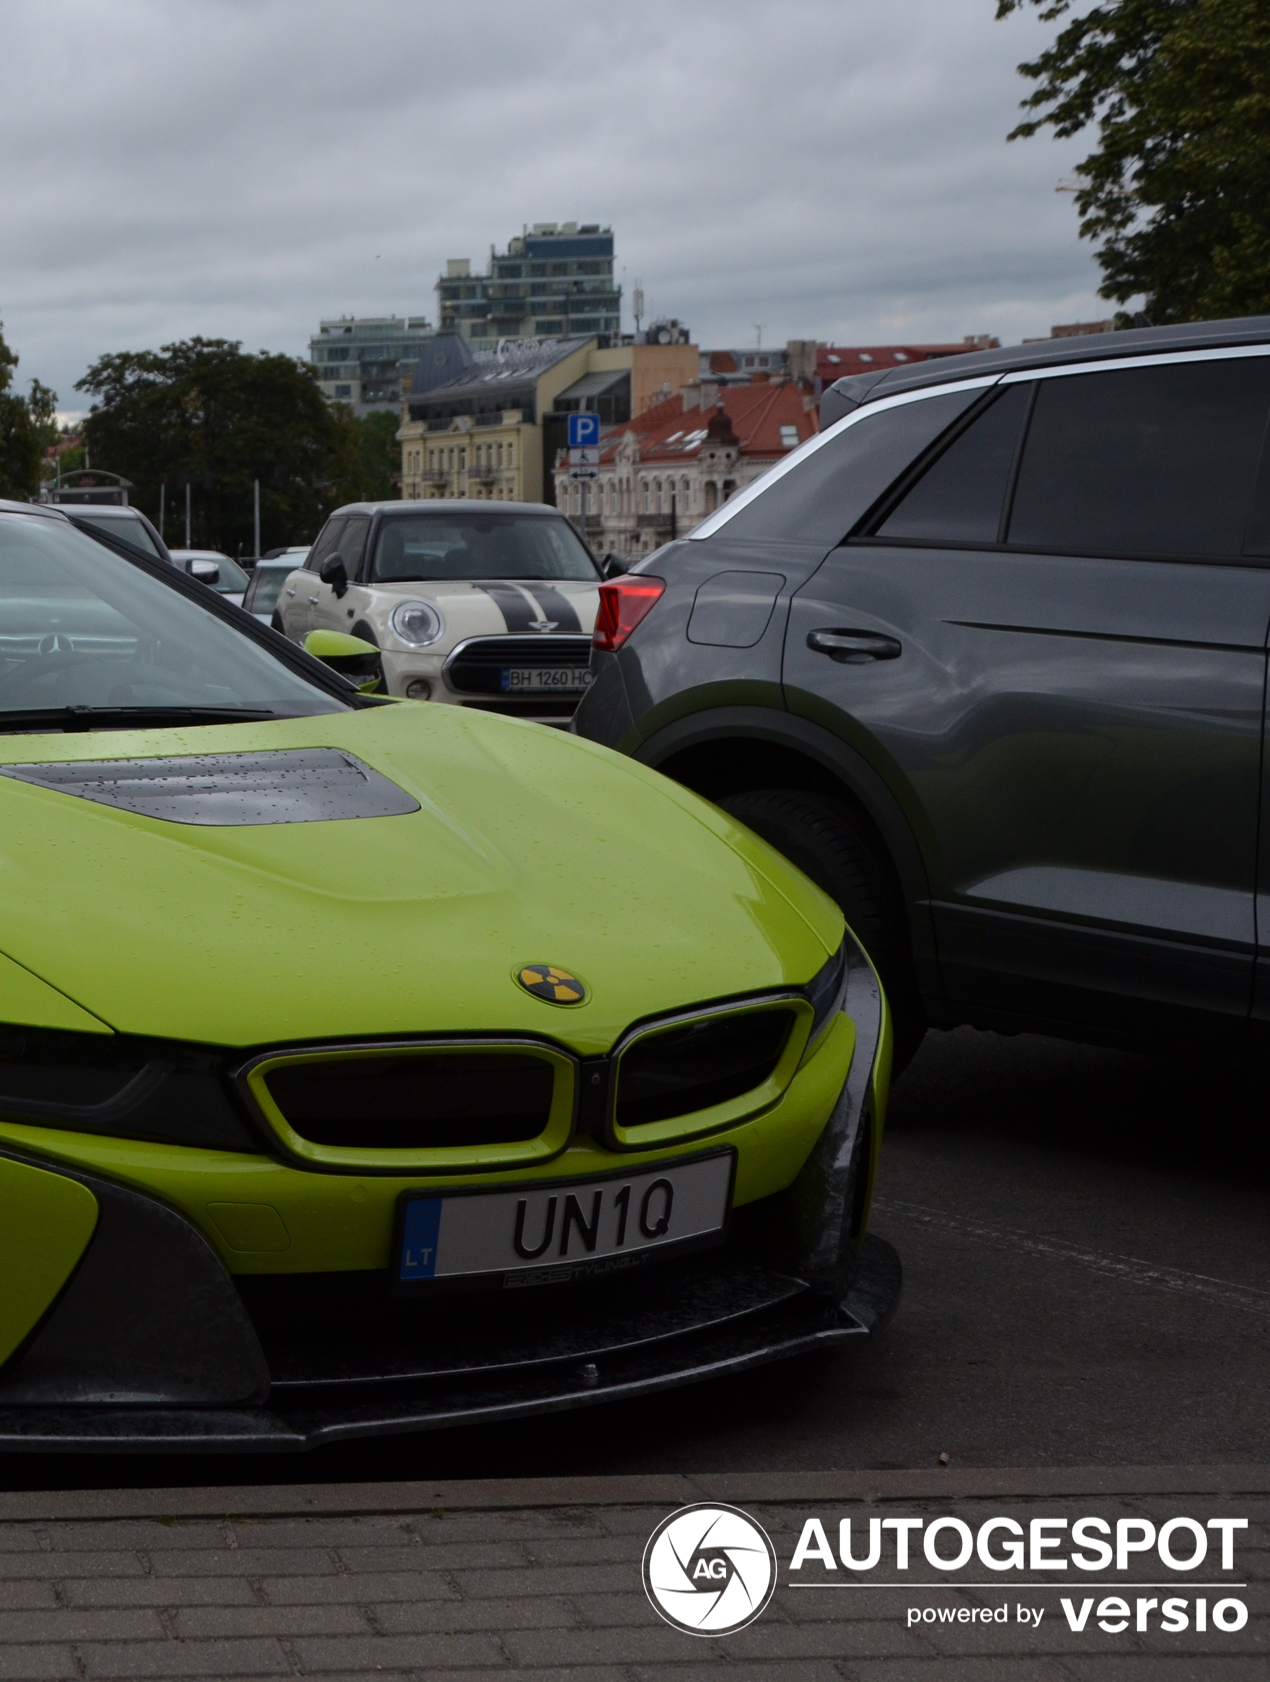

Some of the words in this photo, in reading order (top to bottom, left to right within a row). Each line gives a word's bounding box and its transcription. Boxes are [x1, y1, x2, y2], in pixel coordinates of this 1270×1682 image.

[576, 417, 594, 442] P
[511, 671, 531, 685] BH
[536, 671, 568, 685] 1260
[571, 670, 592, 685] HC
[514, 1176, 674, 1260] UN1Q
[405, 1247, 433, 1267] LT
